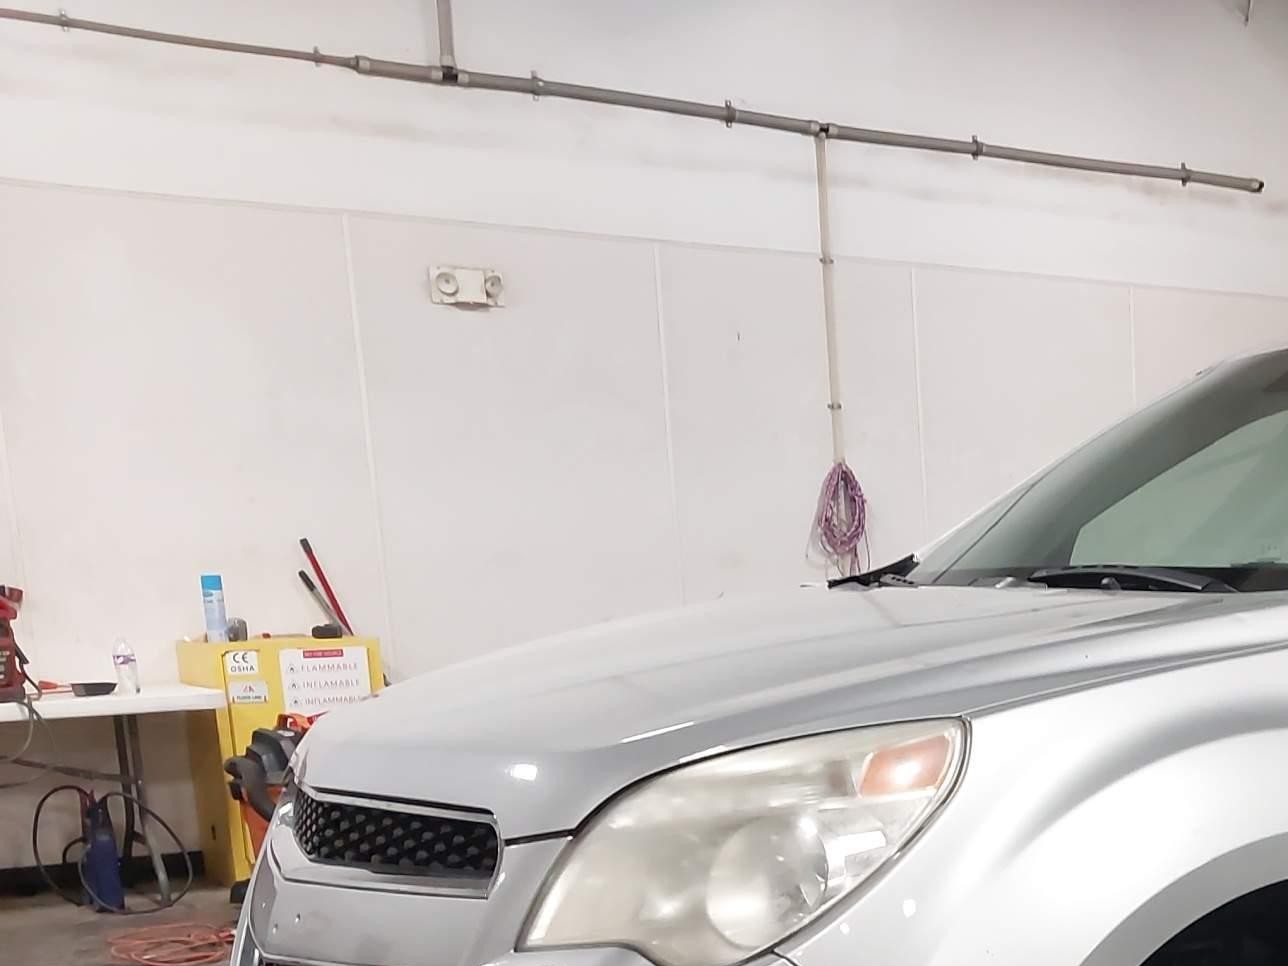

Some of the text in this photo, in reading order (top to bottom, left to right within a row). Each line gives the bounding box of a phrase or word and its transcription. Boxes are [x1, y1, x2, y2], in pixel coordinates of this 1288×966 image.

[232, 652, 249, 664] CE
[230, 665, 255, 673] OSHA
[300, 663, 358, 673] FLAMMABLE
[303, 679, 360, 689] INFLAMABLE
